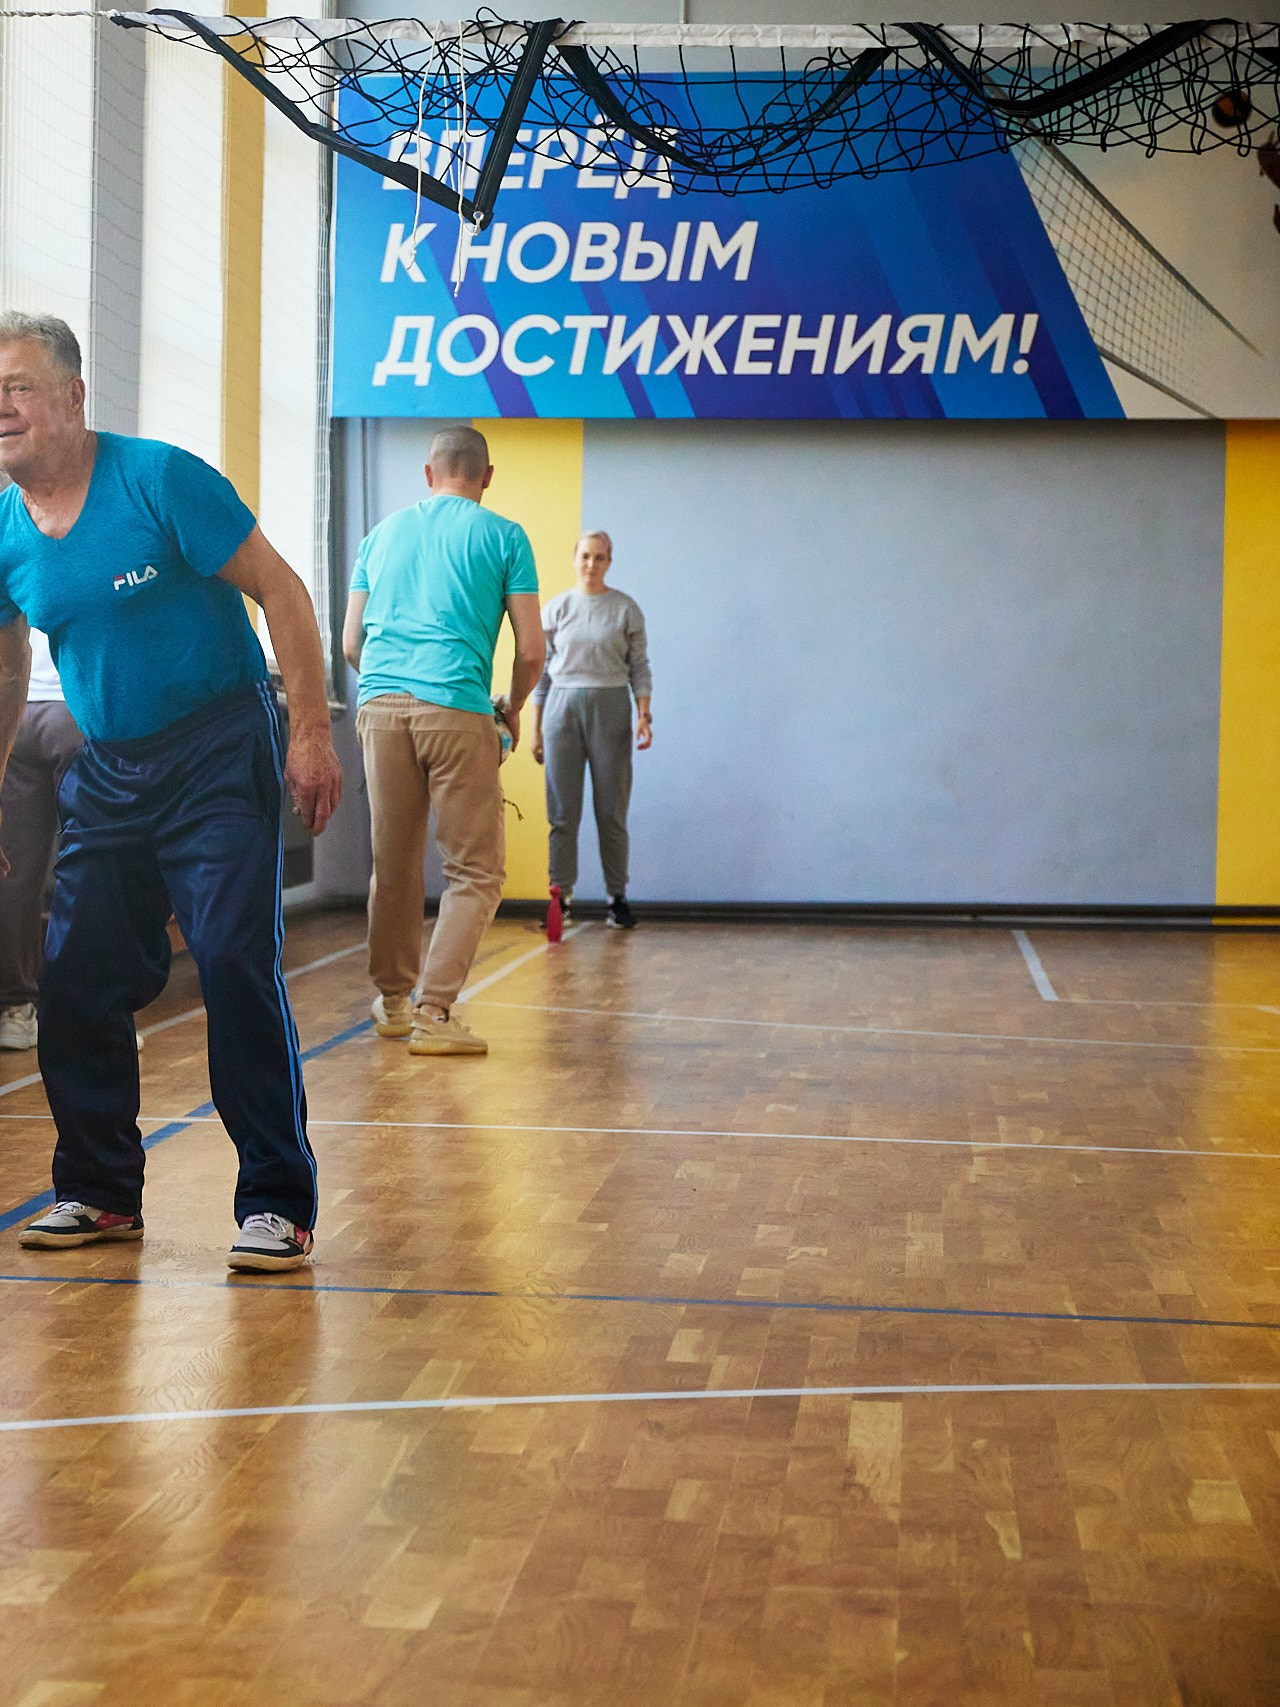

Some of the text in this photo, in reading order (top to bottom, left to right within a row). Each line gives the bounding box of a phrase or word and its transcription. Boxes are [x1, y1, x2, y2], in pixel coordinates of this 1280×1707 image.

[379, 220, 759, 284] К НОВЫМ
[371, 312, 1039, 386] ДОСТИЖЕНИЯМ!
[113, 565, 158, 591] FILA
